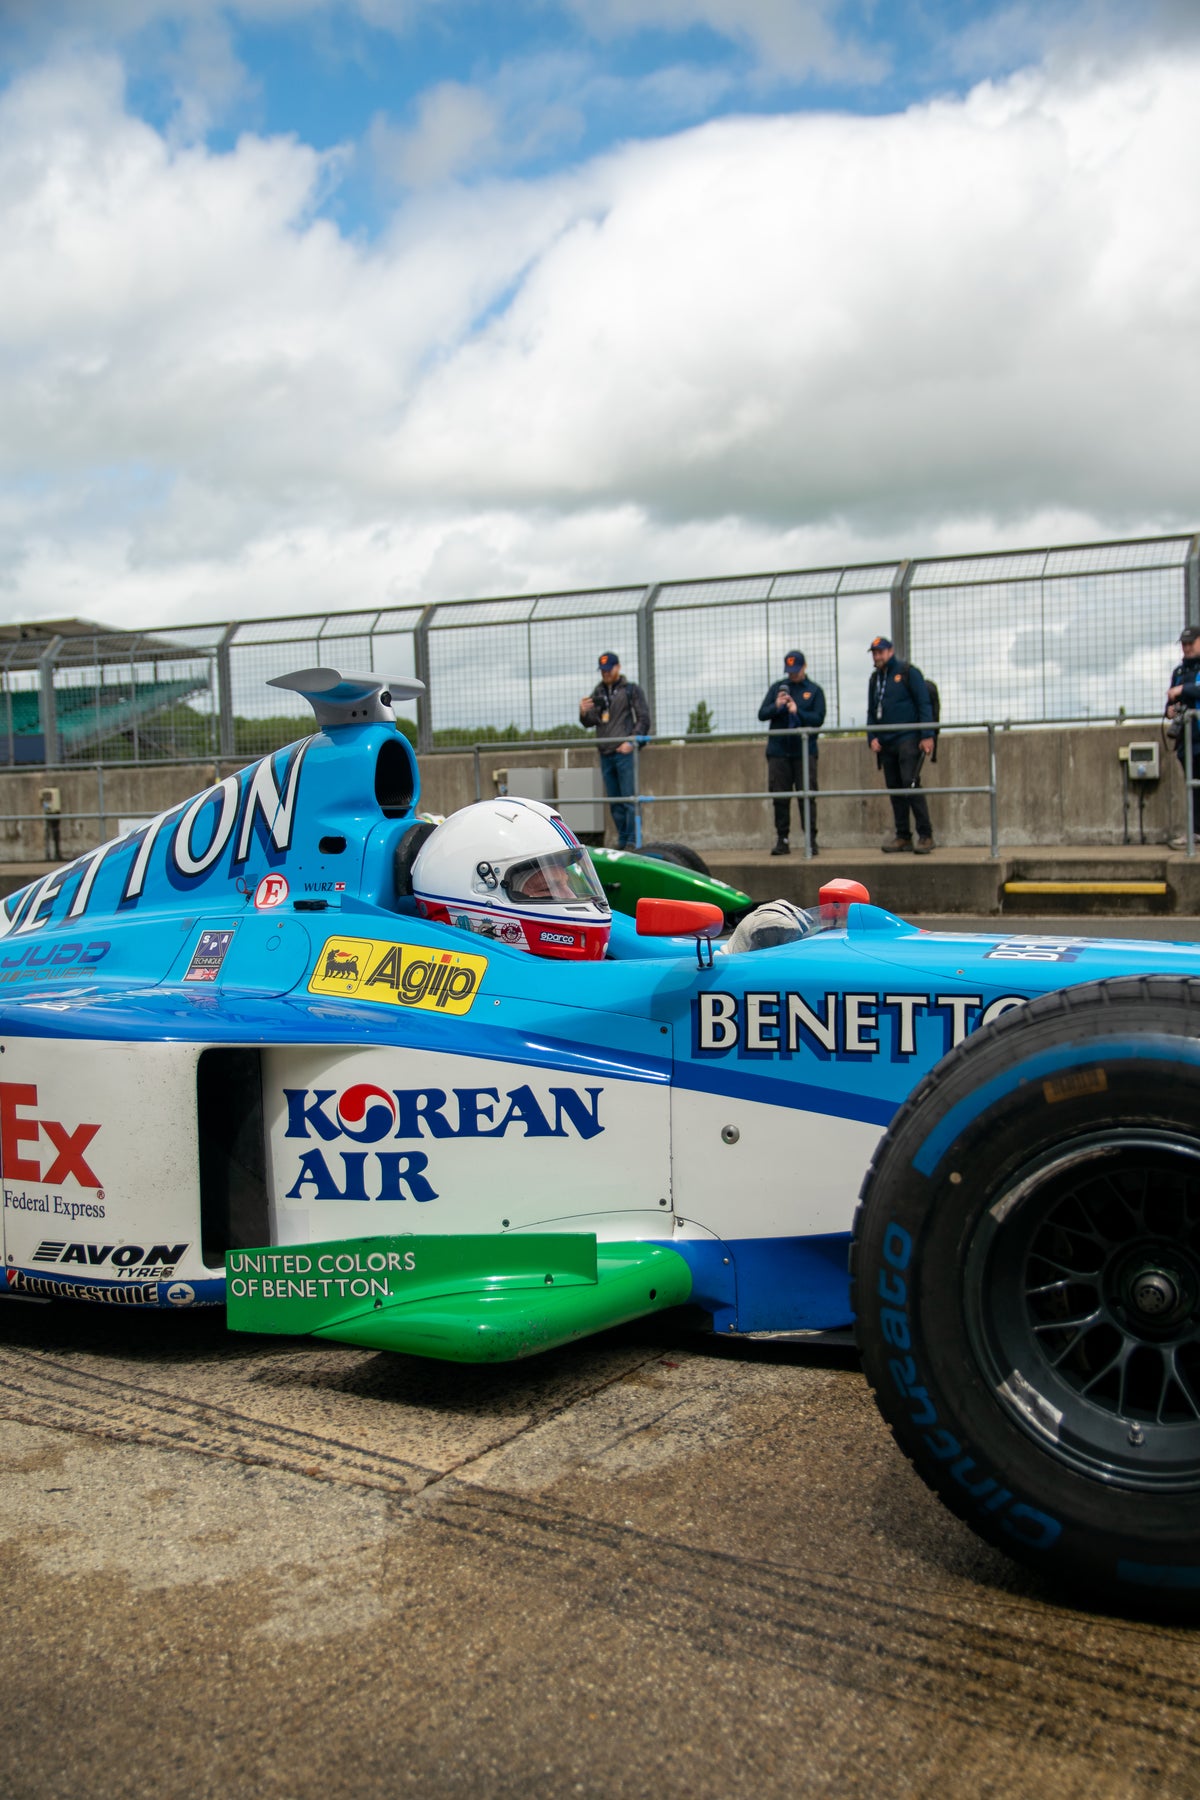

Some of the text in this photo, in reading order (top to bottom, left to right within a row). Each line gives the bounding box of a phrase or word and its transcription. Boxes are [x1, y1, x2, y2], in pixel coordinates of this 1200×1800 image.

[304, 882, 333, 892] WURZ
[541, 932, 574, 943] sparco
[1, 941, 112, 969] JUDD
[20, 966, 97, 981] POWER
[364, 946, 476, 1008] Agip
[283, 1083, 605, 1143] KOREAN
[285, 1148, 440, 1203] AIR
[4, 1190, 106, 1220] Federal Express
[60, 1243, 190, 1267] AVON
[229, 1251, 416, 1274] UNITED COLORS
[8, 1269, 158, 1305] BRIDGESTONE
[231, 1277, 394, 1298] OF BENETTON.
